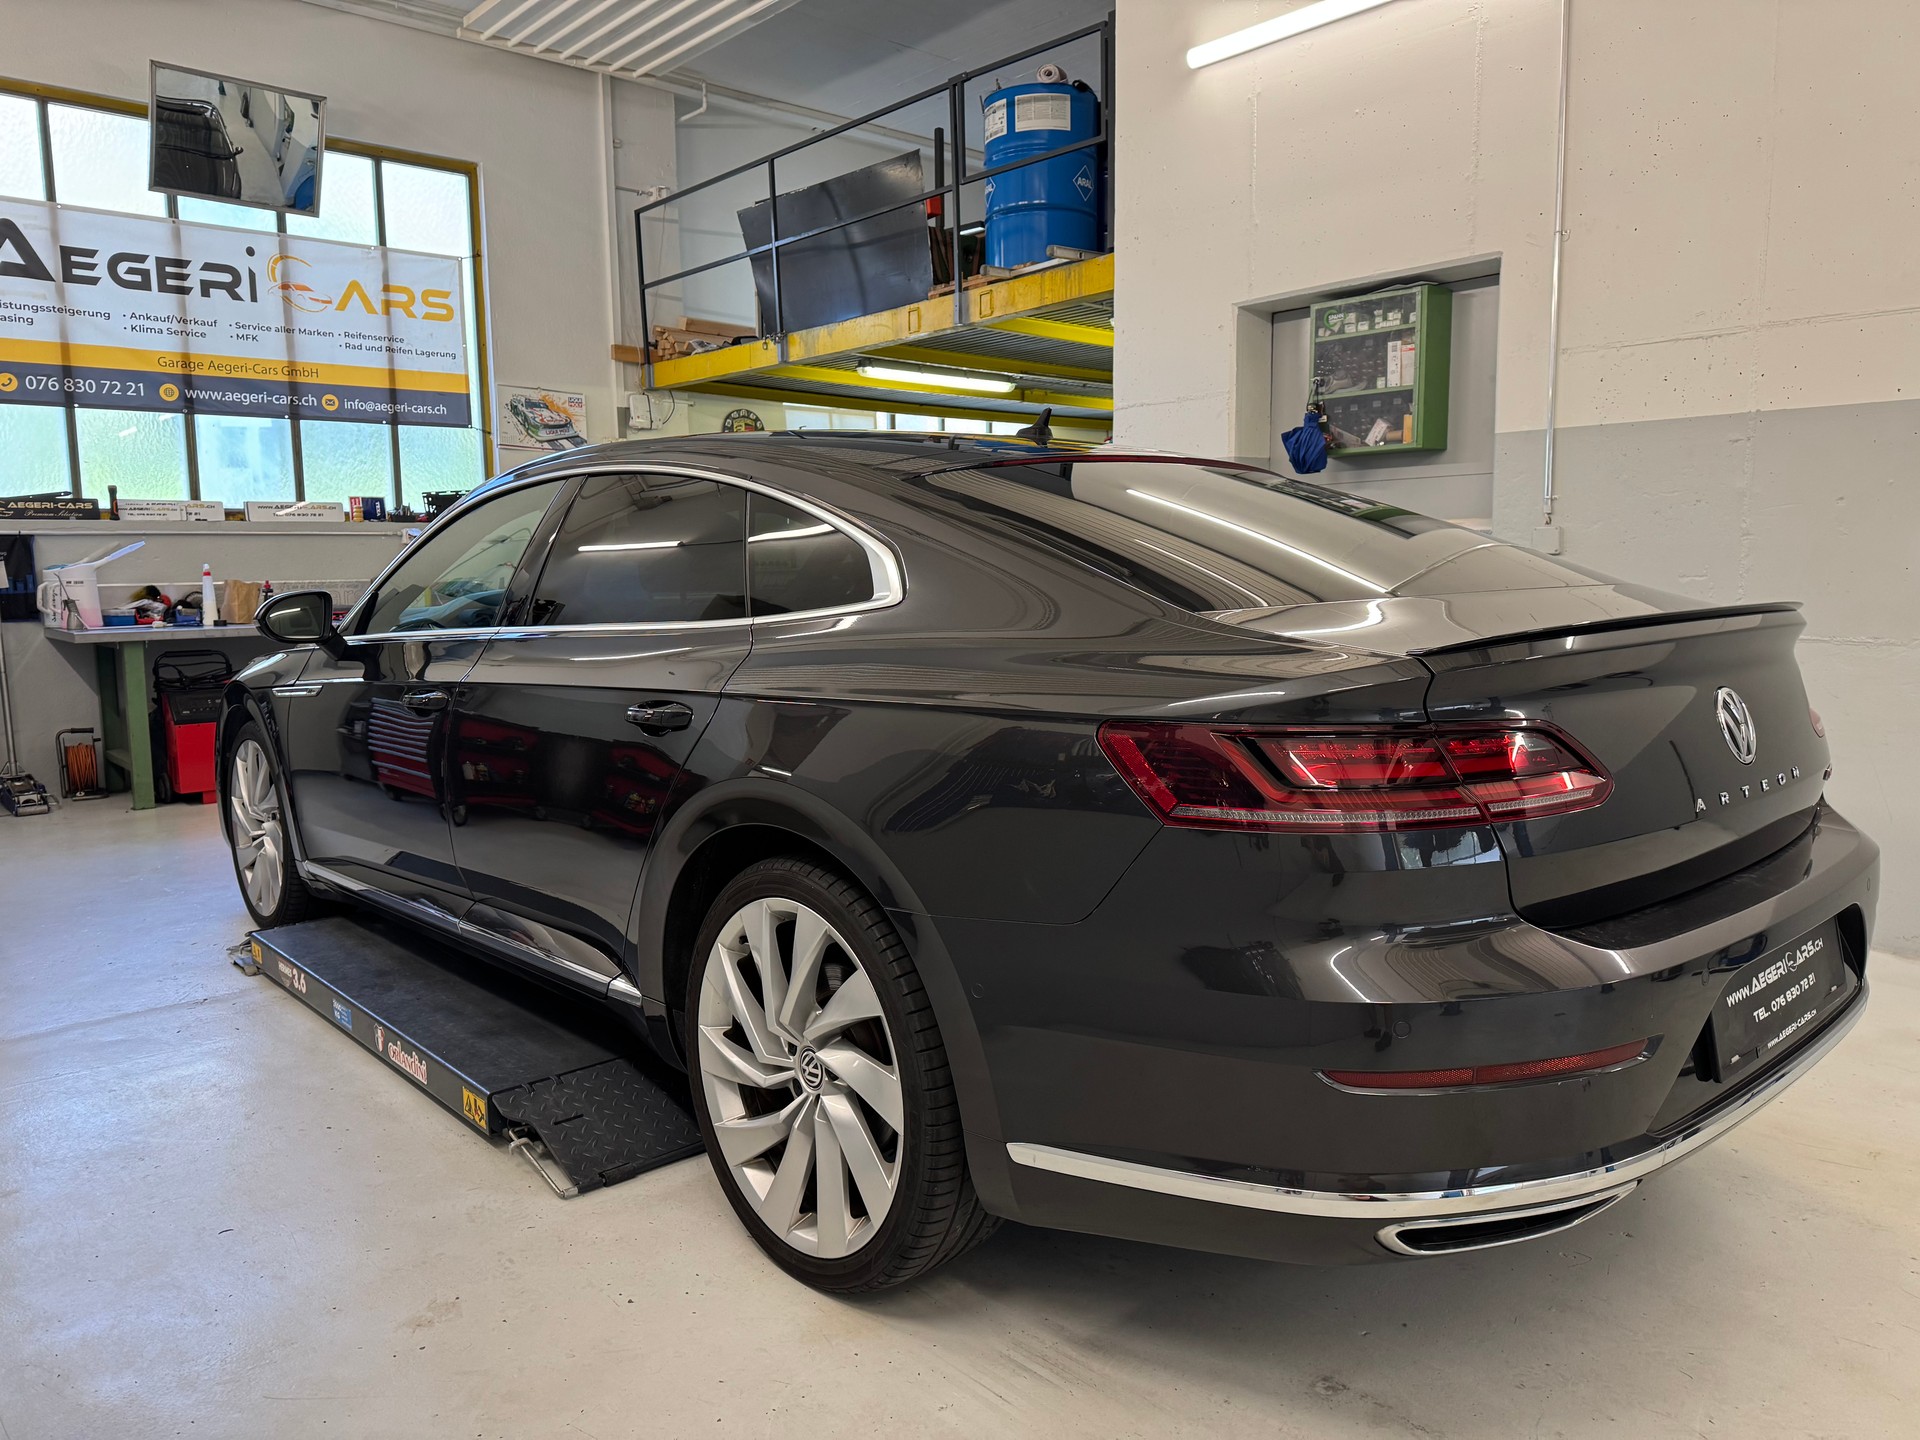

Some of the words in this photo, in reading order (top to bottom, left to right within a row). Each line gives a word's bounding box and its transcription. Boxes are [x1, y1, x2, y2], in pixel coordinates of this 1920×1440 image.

[130, 312, 218, 328] Ankauf/Verkauf
[131, 324, 163, 335] Klima
[167, 327, 207, 338] Service
[235, 321, 272, 332] Service
[275, 326, 296, 334] aller
[298, 327, 334, 338] Marken
[236, 333, 259, 342] MFK
[344, 331, 405, 344] Reifenservice
[345, 342, 363, 351] Rad
[365, 344, 383, 352] und
[385, 345, 413, 355] Reifen
[415, 348, 457, 360] Lagerung
[157, 356, 204, 372] Garage
[207, 360, 278, 376] Aegeri-Cars
[281, 365, 319, 378] GmbH
[25, 375, 59, 391] 076
[64, 378, 96, 394] 830
[100, 380, 122, 395] 72
[126, 382, 144, 397] 21
[185, 388, 318, 407] www.aegeri-cars.ch
[344, 398, 447, 415] info@aegeri-cars.ch
[7, 501, 93, 509] AEGERI-CARS
[1696, 766, 1800, 813] ARTEON
[1753, 1007, 1771, 1023] TEL.
[1770, 993, 1786, 1012] 076
[1785, 986, 1801, 1003] 830
[1800, 980, 1809, 993] 72
[1808, 973, 1816, 985] 21
